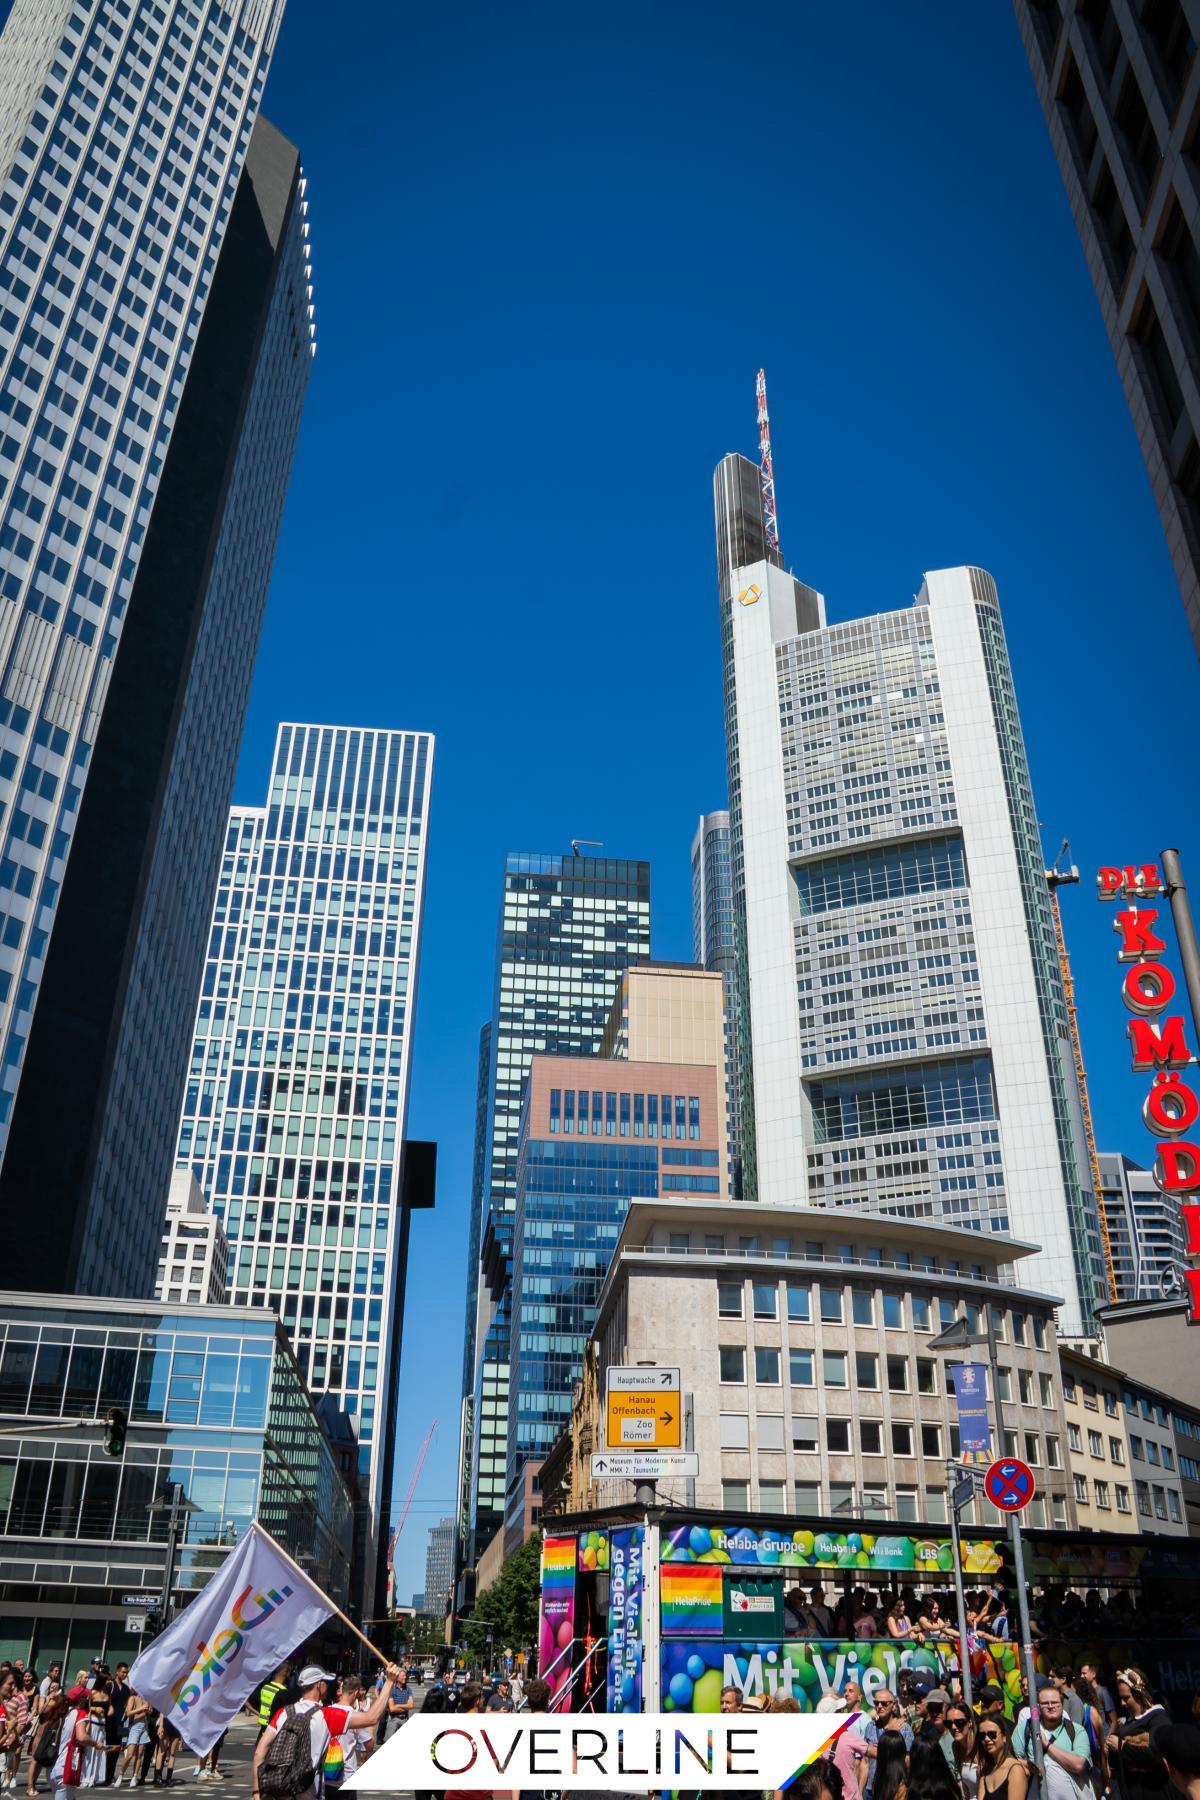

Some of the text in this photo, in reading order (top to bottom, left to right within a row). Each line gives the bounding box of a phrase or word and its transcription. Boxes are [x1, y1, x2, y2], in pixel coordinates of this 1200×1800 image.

[1097, 864, 1162, 893] DIE
[617, 1376, 656, 1386] Hauptwache
[628, 1396, 656, 1404] Hanau
[612, 1407, 656, 1415] Offenbach
[637, 1420, 653, 1428] Zoo
[623, 1431, 652, 1439] Römer
[609, 1457, 633, 1465] Museum
[717, 1535, 806, 1554] Helaba-Gruppe
[919, 1548, 938, 1560] LBS
[612, 1548, 625, 1621] gegen
[625, 1547, 641, 1679] Mit Vielfalt
[723, 1650, 800, 1699] Mit
